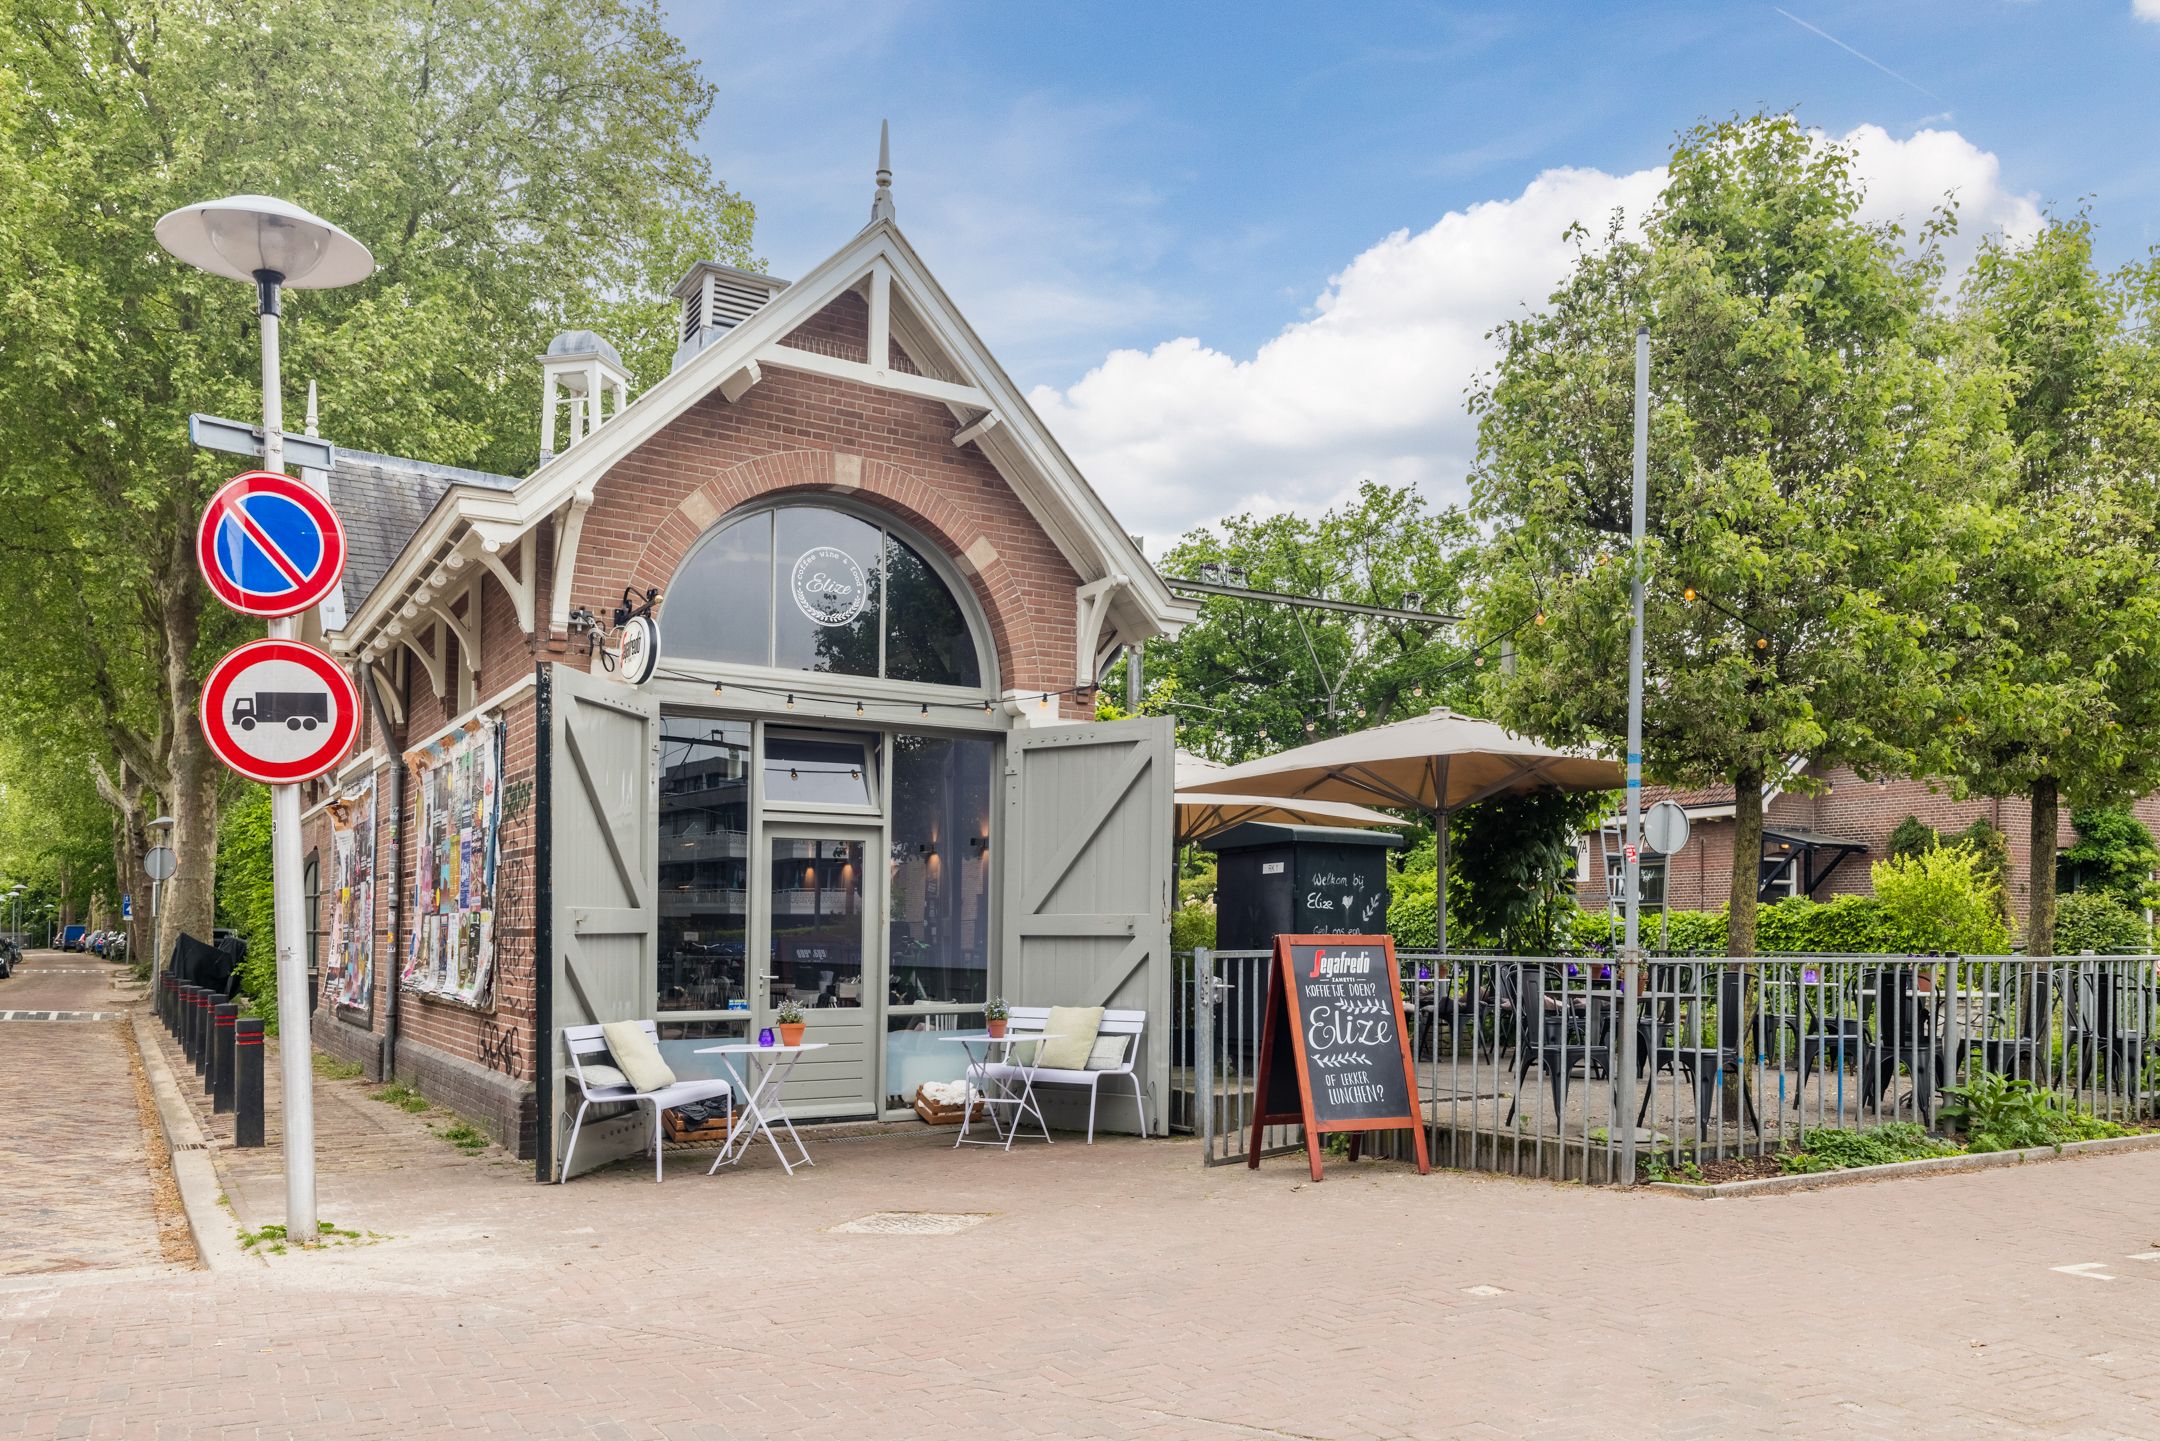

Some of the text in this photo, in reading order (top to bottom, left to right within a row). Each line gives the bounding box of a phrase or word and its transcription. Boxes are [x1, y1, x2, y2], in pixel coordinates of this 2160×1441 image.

[798, 554, 816, 580] coffee
[850, 566, 862, 587] food
[806, 572, 852, 595] Elize
[1312, 872, 1365, 890] Welkom bij
[1307, 892, 1334, 910] Elize
[1309, 949, 1370, 978] Segafredo
[1305, 982, 1376, 998] KOFFIETJE DOEN?
[1308, 1005, 1392, 1050] Elize
[1325, 1071, 1370, 1087] OF LEKKER
[1328, 1084, 1385, 1105] LUNCHEN?
